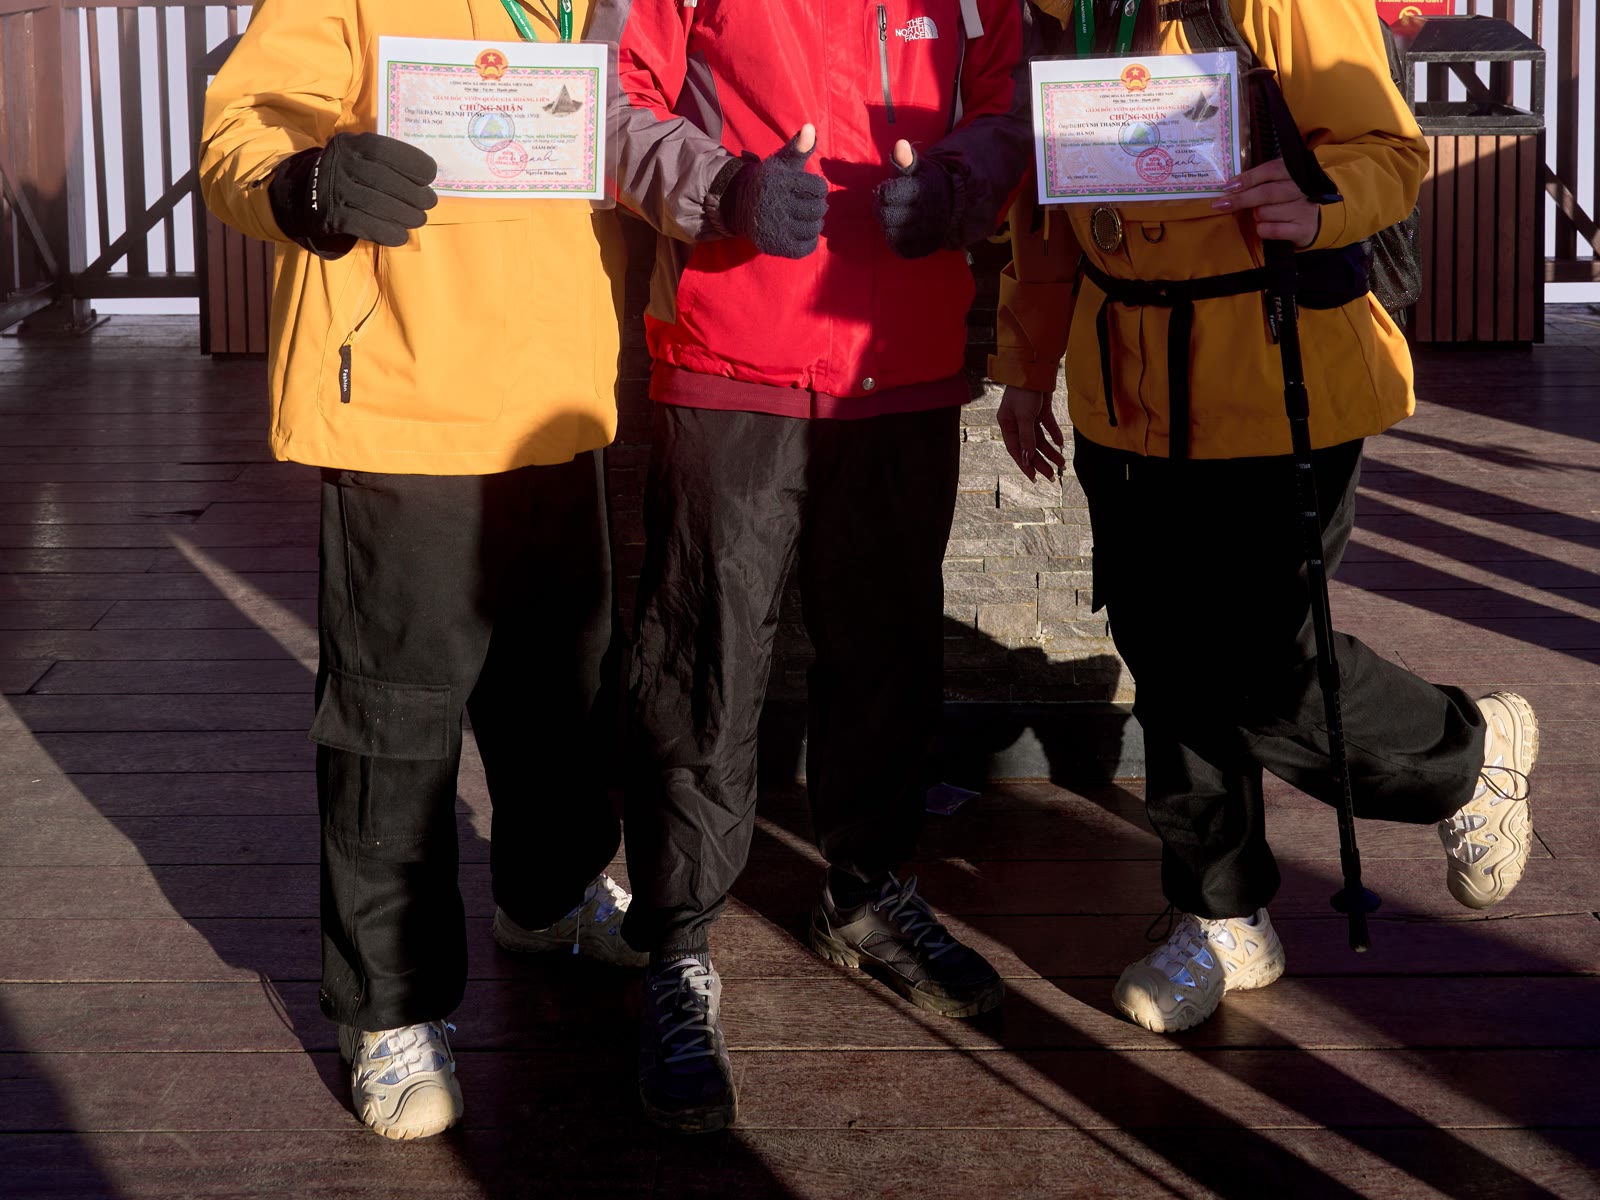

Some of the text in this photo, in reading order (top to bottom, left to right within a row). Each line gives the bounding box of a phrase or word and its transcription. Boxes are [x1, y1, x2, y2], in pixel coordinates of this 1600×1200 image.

[906, 16, 923, 28] THE
[895, 24, 924, 36] NORTH
[904, 32, 926, 42] FACE
[1109, 113, 1139, 121] CHỨNG
[1274, 296, 1284, 322] TEAM
[1269, 314, 1277, 336] Fashion
